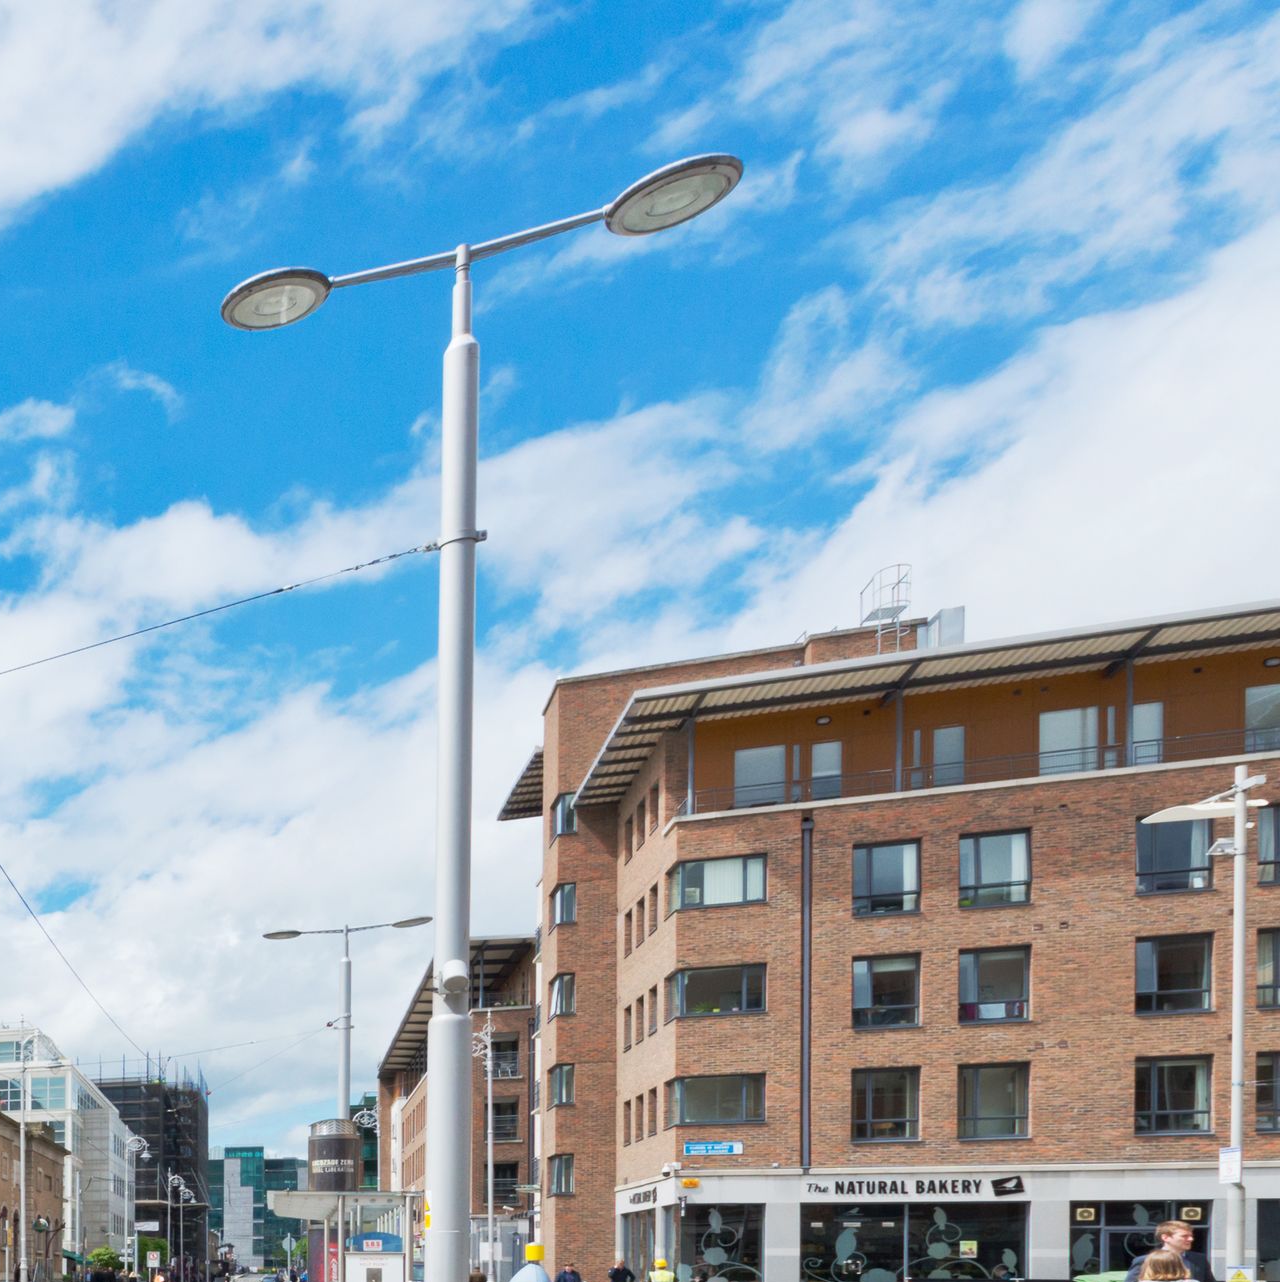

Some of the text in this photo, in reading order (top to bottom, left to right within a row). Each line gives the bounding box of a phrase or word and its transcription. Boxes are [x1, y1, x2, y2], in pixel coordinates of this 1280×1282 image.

[806, 1179, 983, 1195] The NATURAL BAKERY
